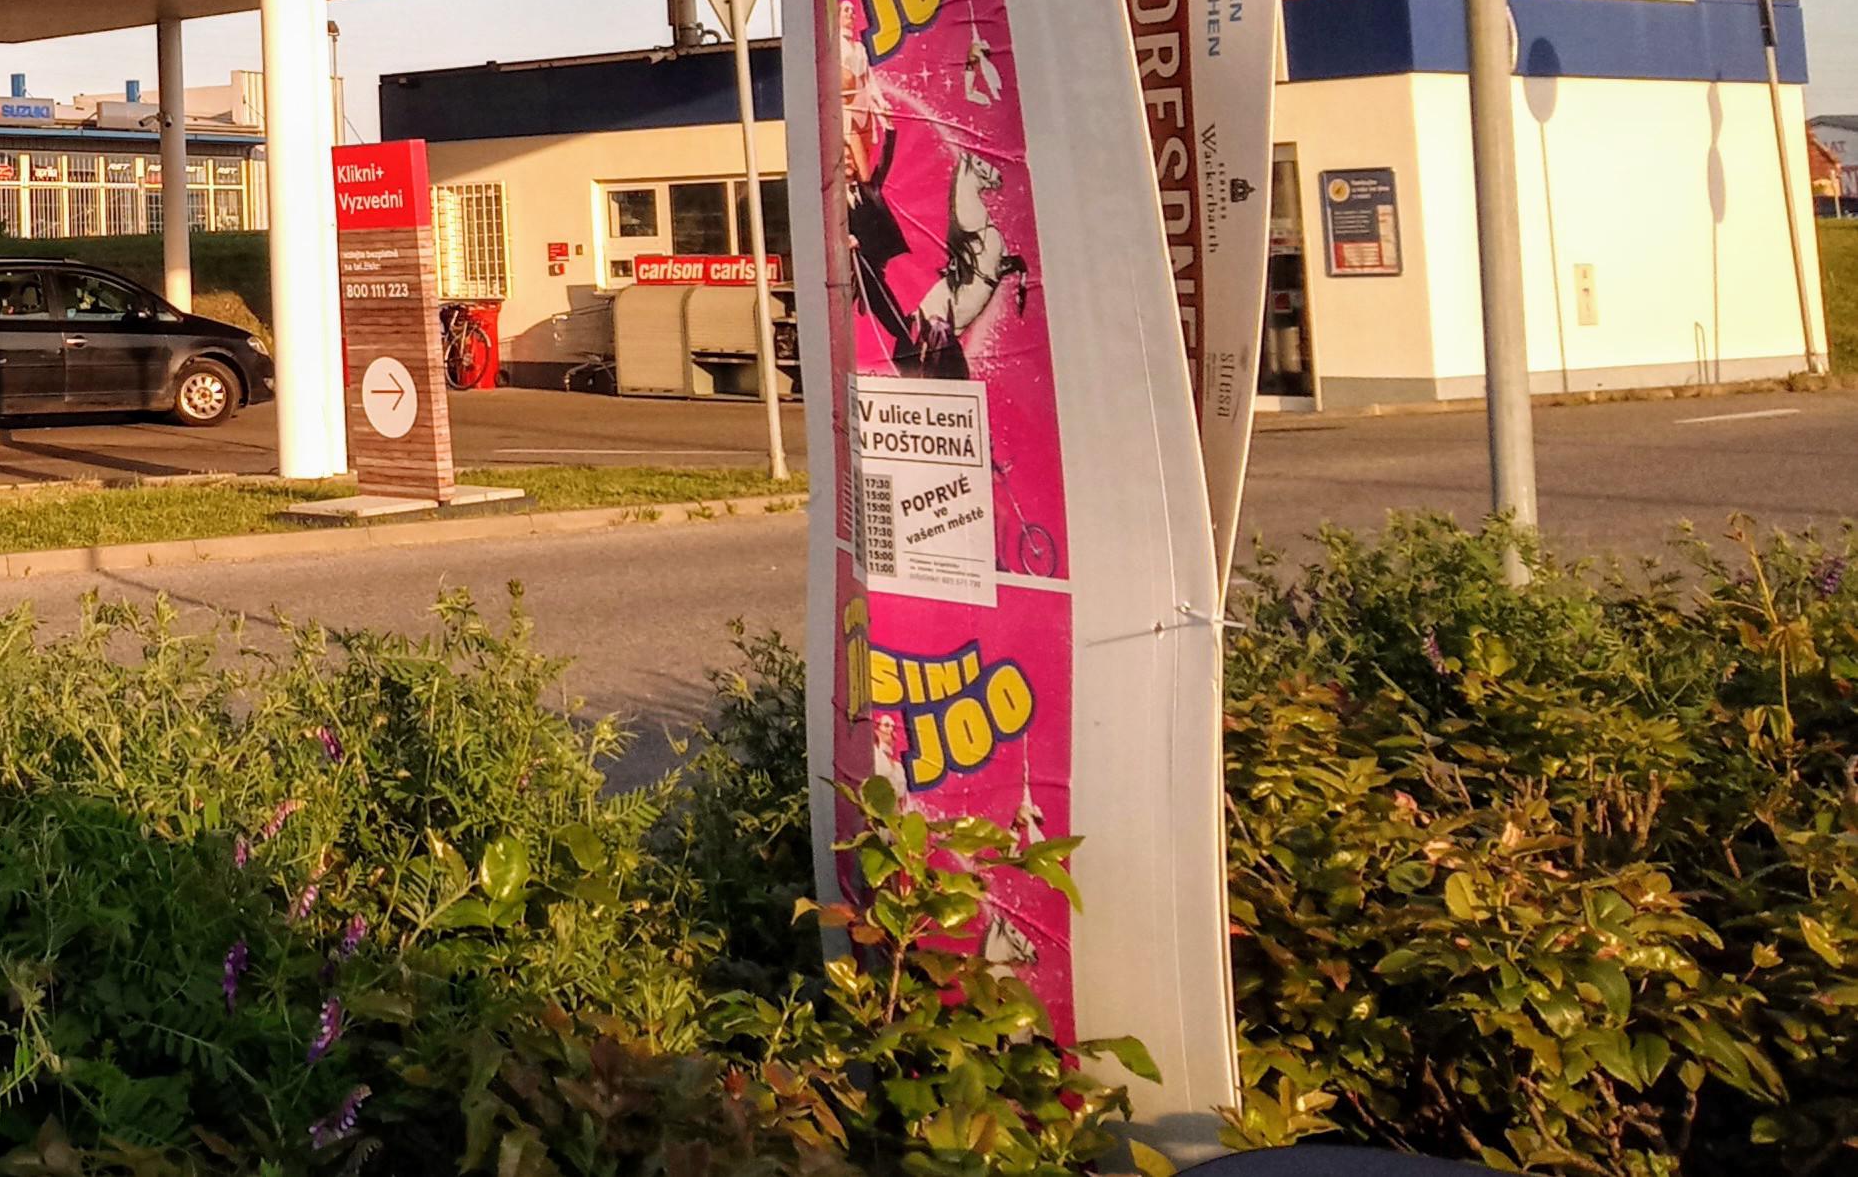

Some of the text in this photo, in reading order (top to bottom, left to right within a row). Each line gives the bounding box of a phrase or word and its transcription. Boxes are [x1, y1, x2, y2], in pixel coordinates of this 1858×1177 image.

[1, 104, 51, 119] SUZUKI
[336, 163, 385, 184] Klikni+
[1200, 121, 1220, 254] Wackerbarth
[338, 189, 404, 215] Vyzvedni
[638, 258, 704, 280] carlson
[710, 258, 778, 280] carlsn
[346, 282, 410, 298] 800 111 223
[879, 404, 922, 425] ulice
[926, 407, 974, 429] Lesní
[873, 430, 976, 458] POŠTORNÁ
[865, 478, 890, 489] 17:30
[900, 473, 972, 517] POPRVÉ
[867, 514, 892, 525] 17:30
[933, 506, 949, 519] ve
[867, 526, 893, 538] 17:30
[905, 506, 985, 545] vašem městě
[868, 538, 894, 549] 17:30
[911, 664, 1033, 784] JOO
